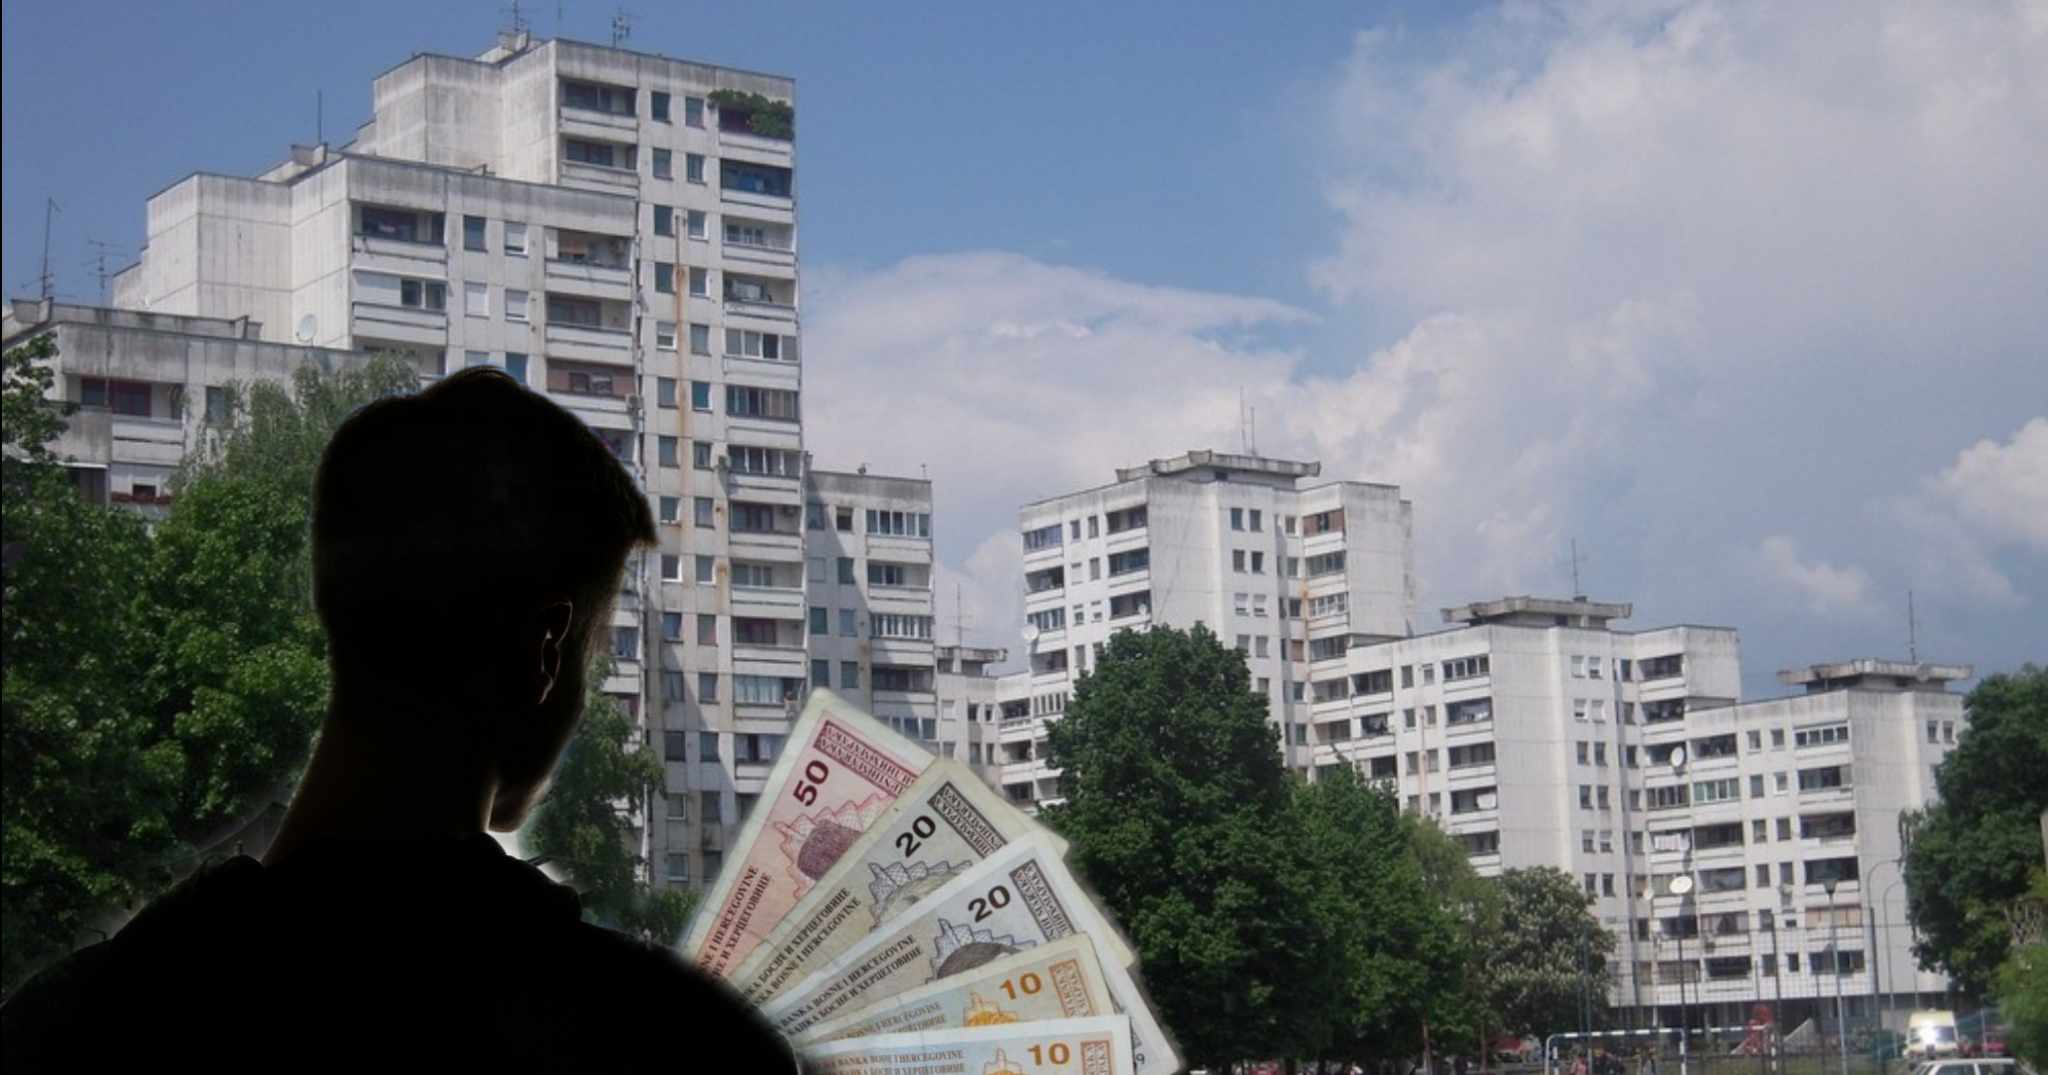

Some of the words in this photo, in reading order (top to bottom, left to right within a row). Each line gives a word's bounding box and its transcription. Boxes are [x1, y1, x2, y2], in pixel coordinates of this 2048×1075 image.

[793, 760, 829, 807] 50
[896, 814, 937, 857] 20
[711, 864, 759, 945] HERCEGOVINE
[968, 885, 1011, 922] 20
[800, 896, 861, 958] HERCEGOVINE
[846, 933, 915, 983] HERCEGOVINE
[1000, 972, 1042, 1000] 10
[1028, 1042, 1070, 1065] 10
